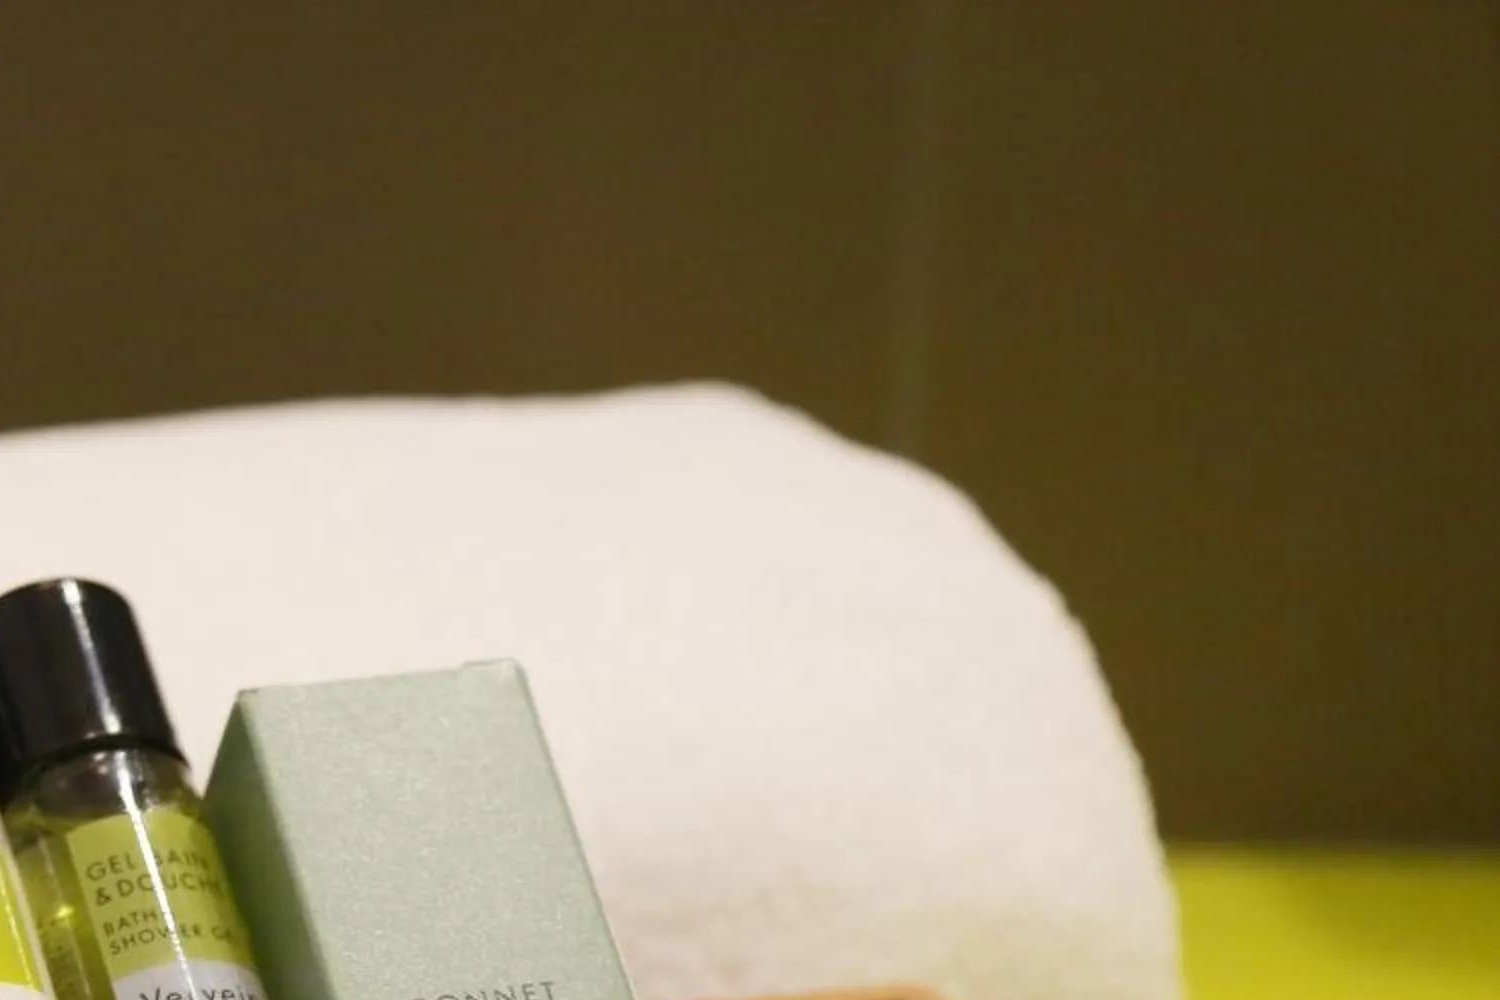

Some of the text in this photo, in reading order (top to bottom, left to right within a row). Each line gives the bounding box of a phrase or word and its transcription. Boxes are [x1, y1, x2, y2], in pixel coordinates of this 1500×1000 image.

[85, 852, 137, 882] GEL
[95, 886, 112, 907] &
[102, 908, 159, 938] BATH
